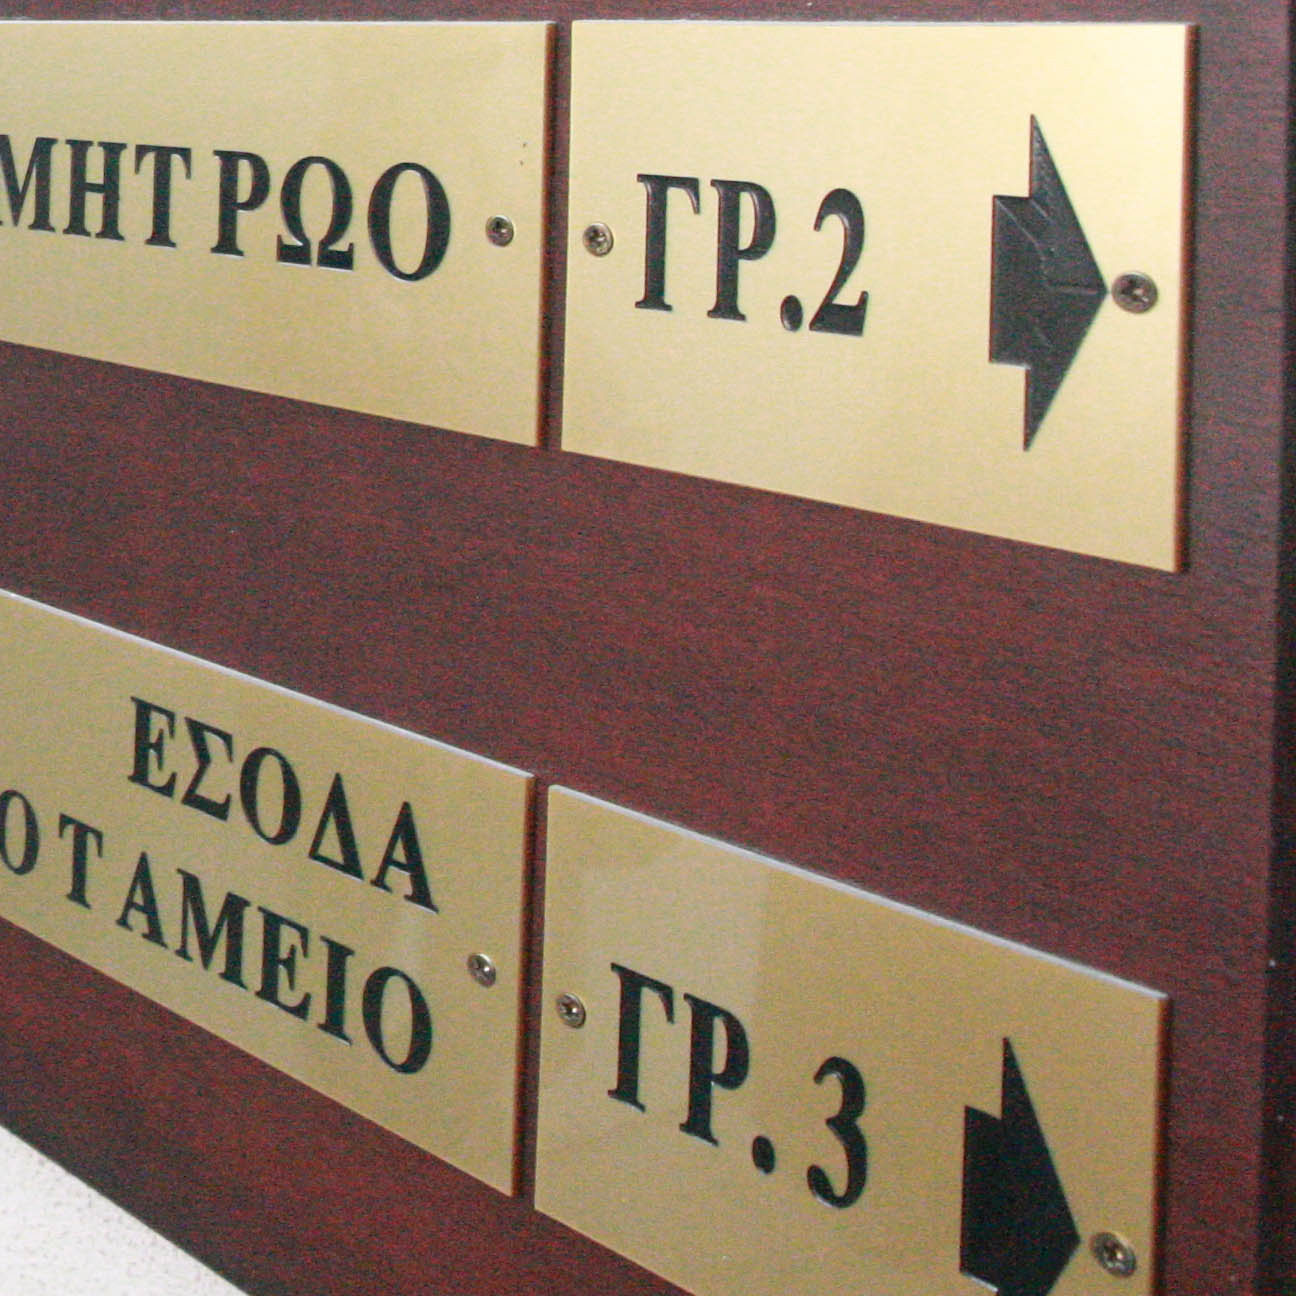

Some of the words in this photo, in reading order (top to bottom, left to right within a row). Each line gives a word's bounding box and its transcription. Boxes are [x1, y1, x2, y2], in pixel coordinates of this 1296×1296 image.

[635, 172, 871, 338] ΓΡ.2
[126, 695, 441, 914] ΕΣΟΔΑ
[606, 962, 869, 1210] ΓΡ.3
